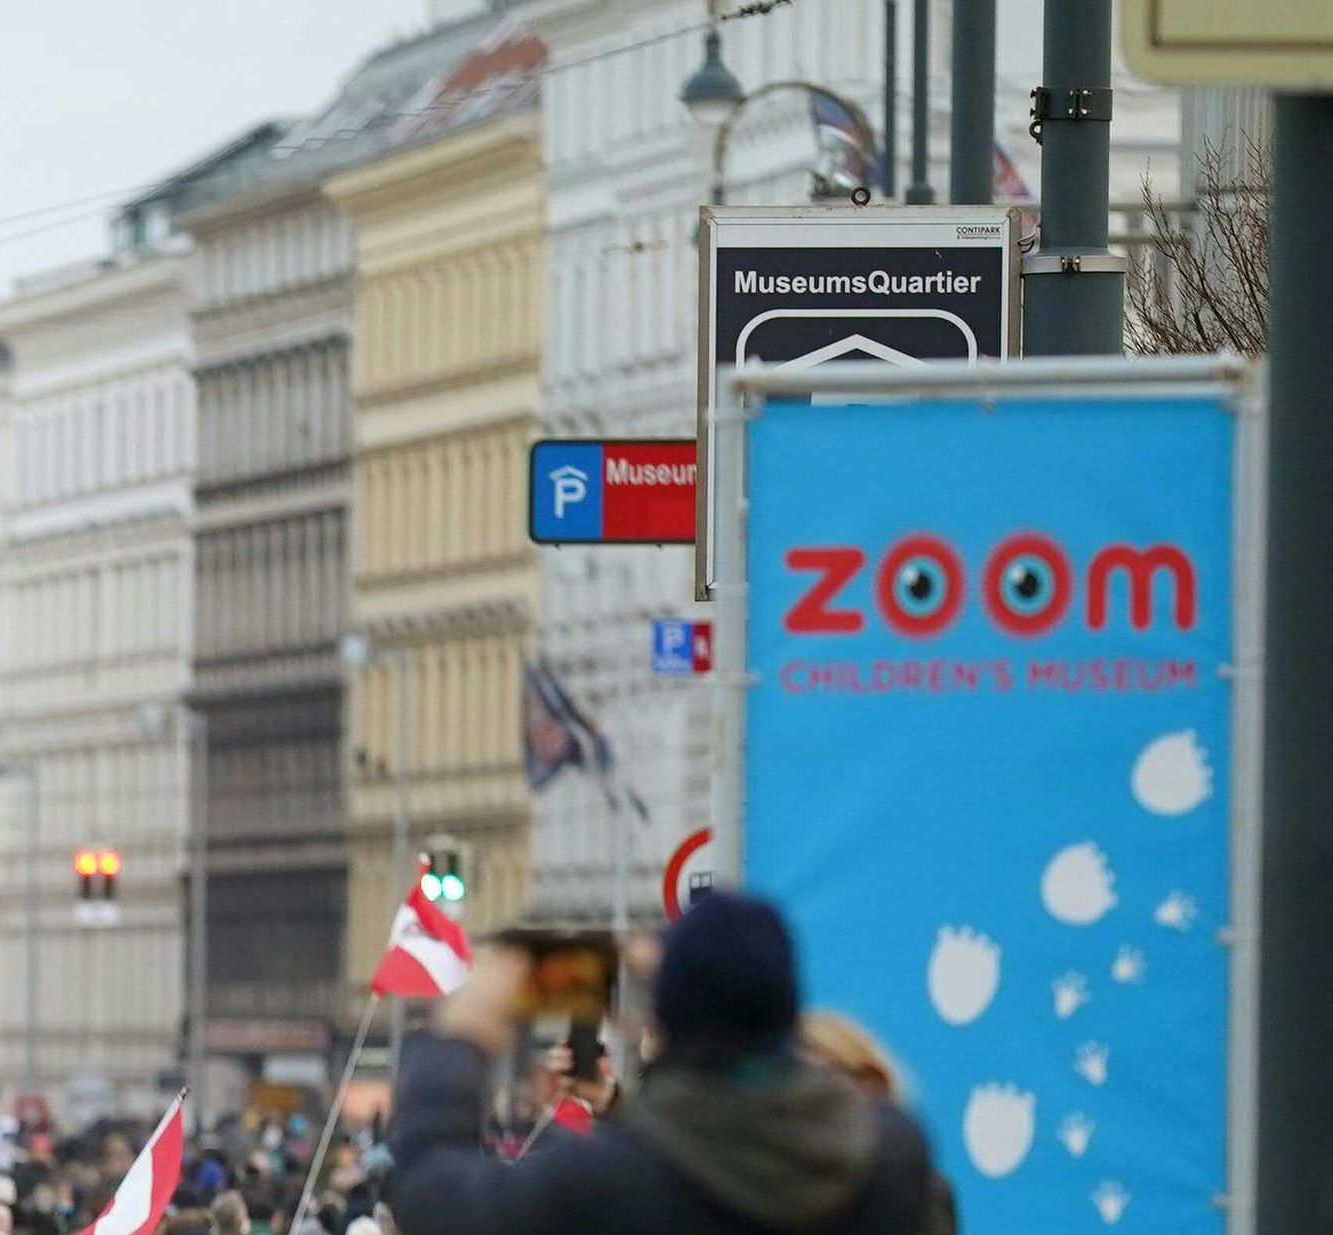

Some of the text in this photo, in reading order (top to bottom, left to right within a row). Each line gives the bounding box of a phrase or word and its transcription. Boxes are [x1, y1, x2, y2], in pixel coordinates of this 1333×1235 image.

[956, 226, 1001, 234] CONTIPARK
[734, 269, 982, 295] MuseumsQuartier
[780, 658, 1196, 694] CHILDREN'S MUSEUM
